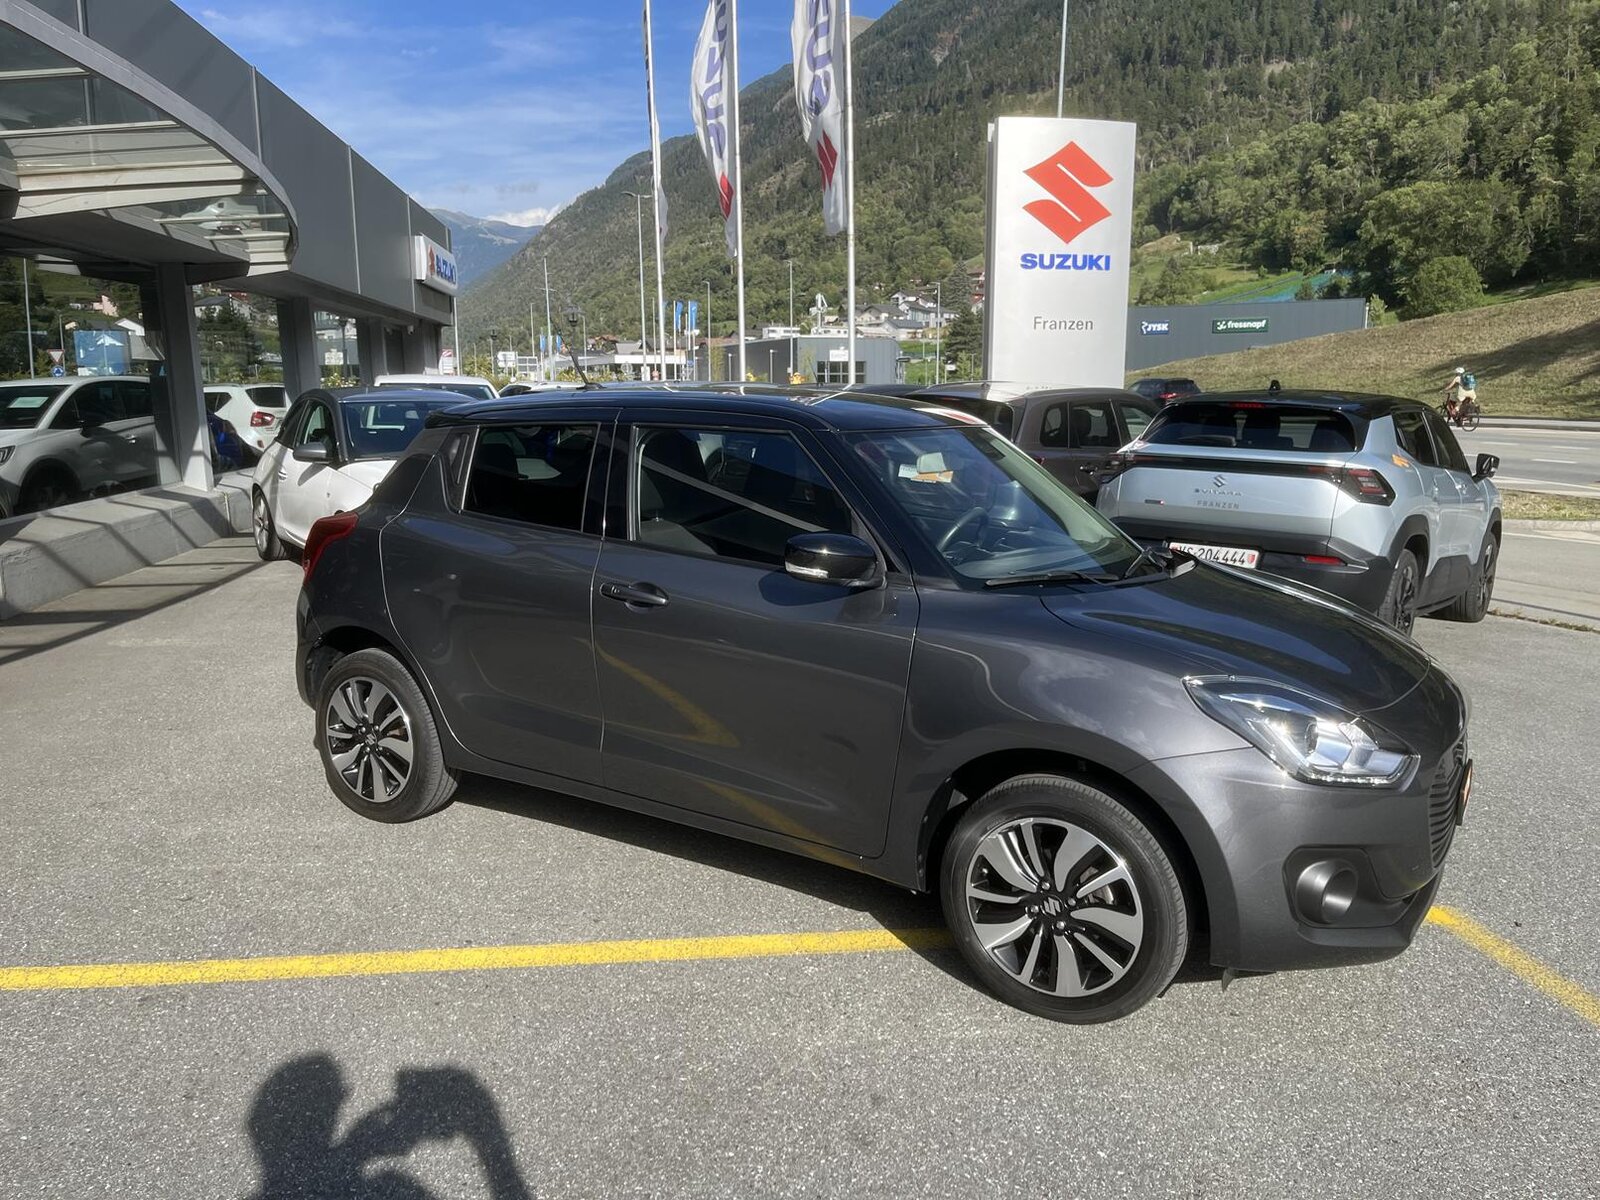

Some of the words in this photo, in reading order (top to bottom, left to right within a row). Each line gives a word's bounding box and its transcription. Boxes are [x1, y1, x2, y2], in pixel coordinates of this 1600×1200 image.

[1020, 253, 1111, 271] SUZUKI
[1033, 316, 1094, 330] Franzen
[1147, 323, 1169, 331] JYSK
[1227, 320, 1267, 329] fressnapf
[1197, 500, 1240, 510] FRANZEN
